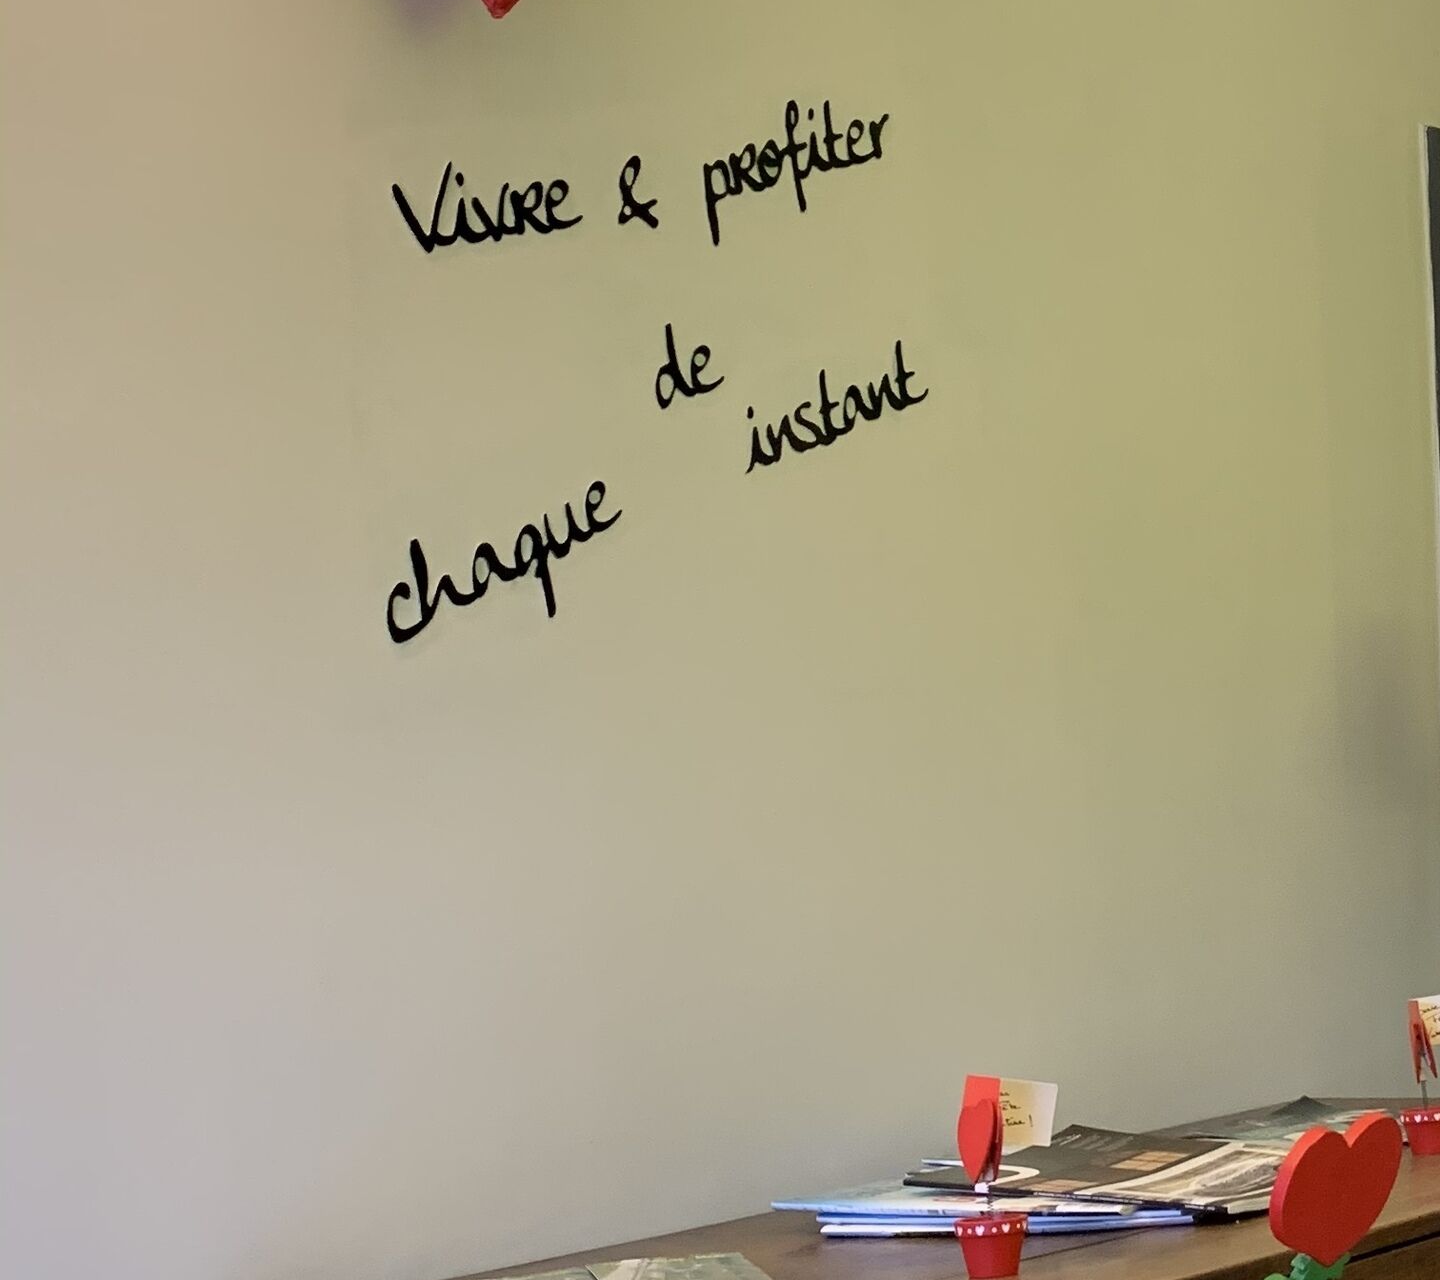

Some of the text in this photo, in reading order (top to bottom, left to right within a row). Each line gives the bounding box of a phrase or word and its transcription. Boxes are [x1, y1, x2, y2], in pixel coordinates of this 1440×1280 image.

[391, 99, 890, 254] Vivre & profiter
[655, 322, 725, 410] de
[386, 339, 929, 644] chaque instant
